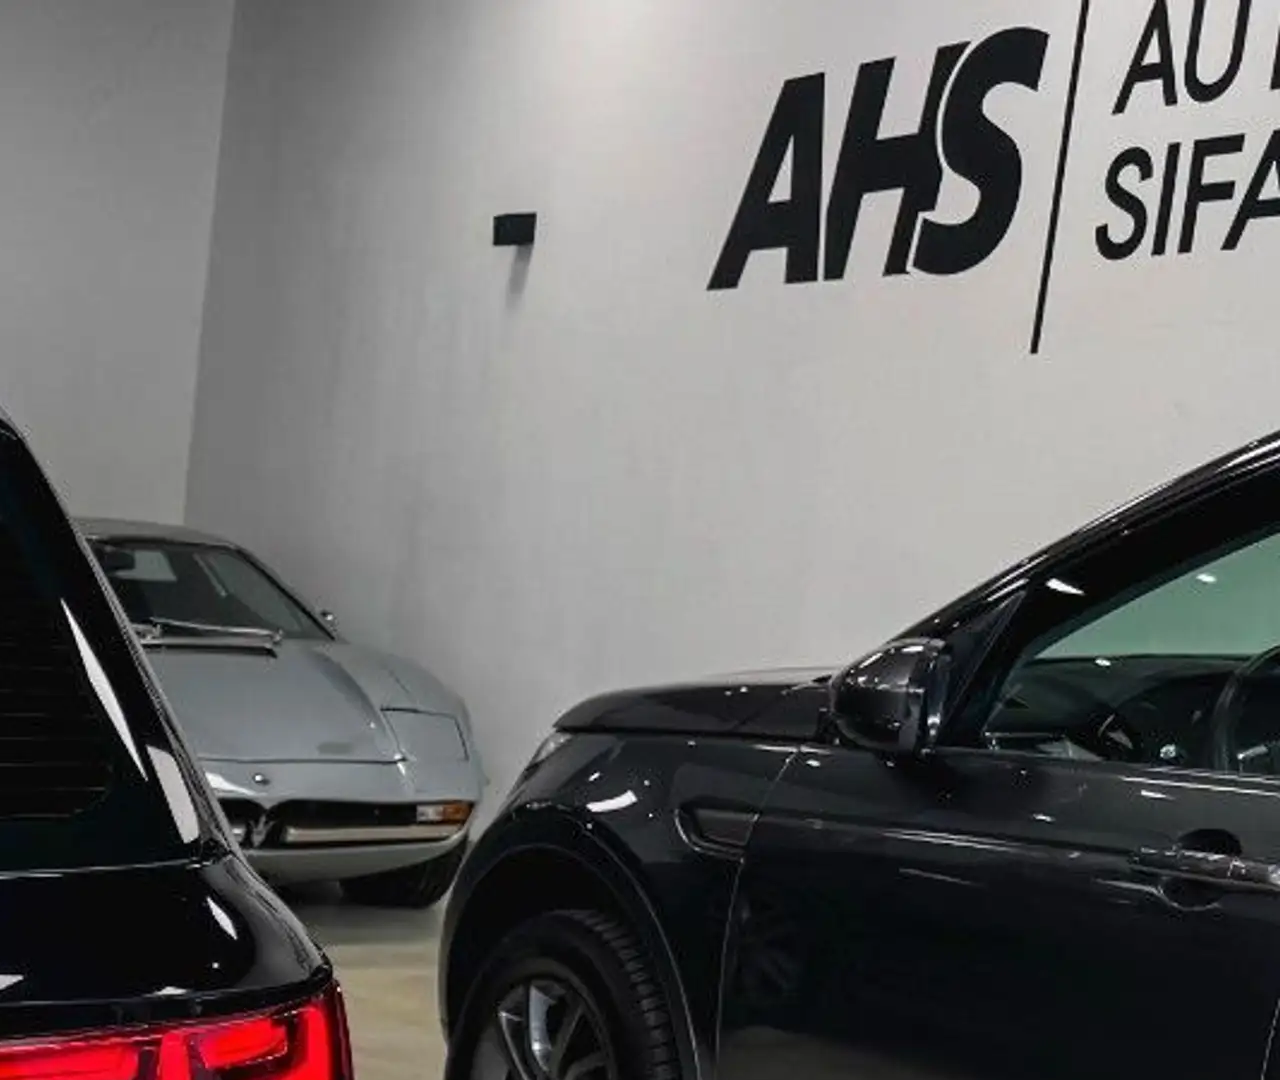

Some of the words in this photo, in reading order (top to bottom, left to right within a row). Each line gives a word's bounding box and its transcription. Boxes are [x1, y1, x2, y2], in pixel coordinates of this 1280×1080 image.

[1112, 0, 1280, 115] AU
[706, 26, 1050, 291] AHS
[1095, 126, 1280, 261] SIFA
